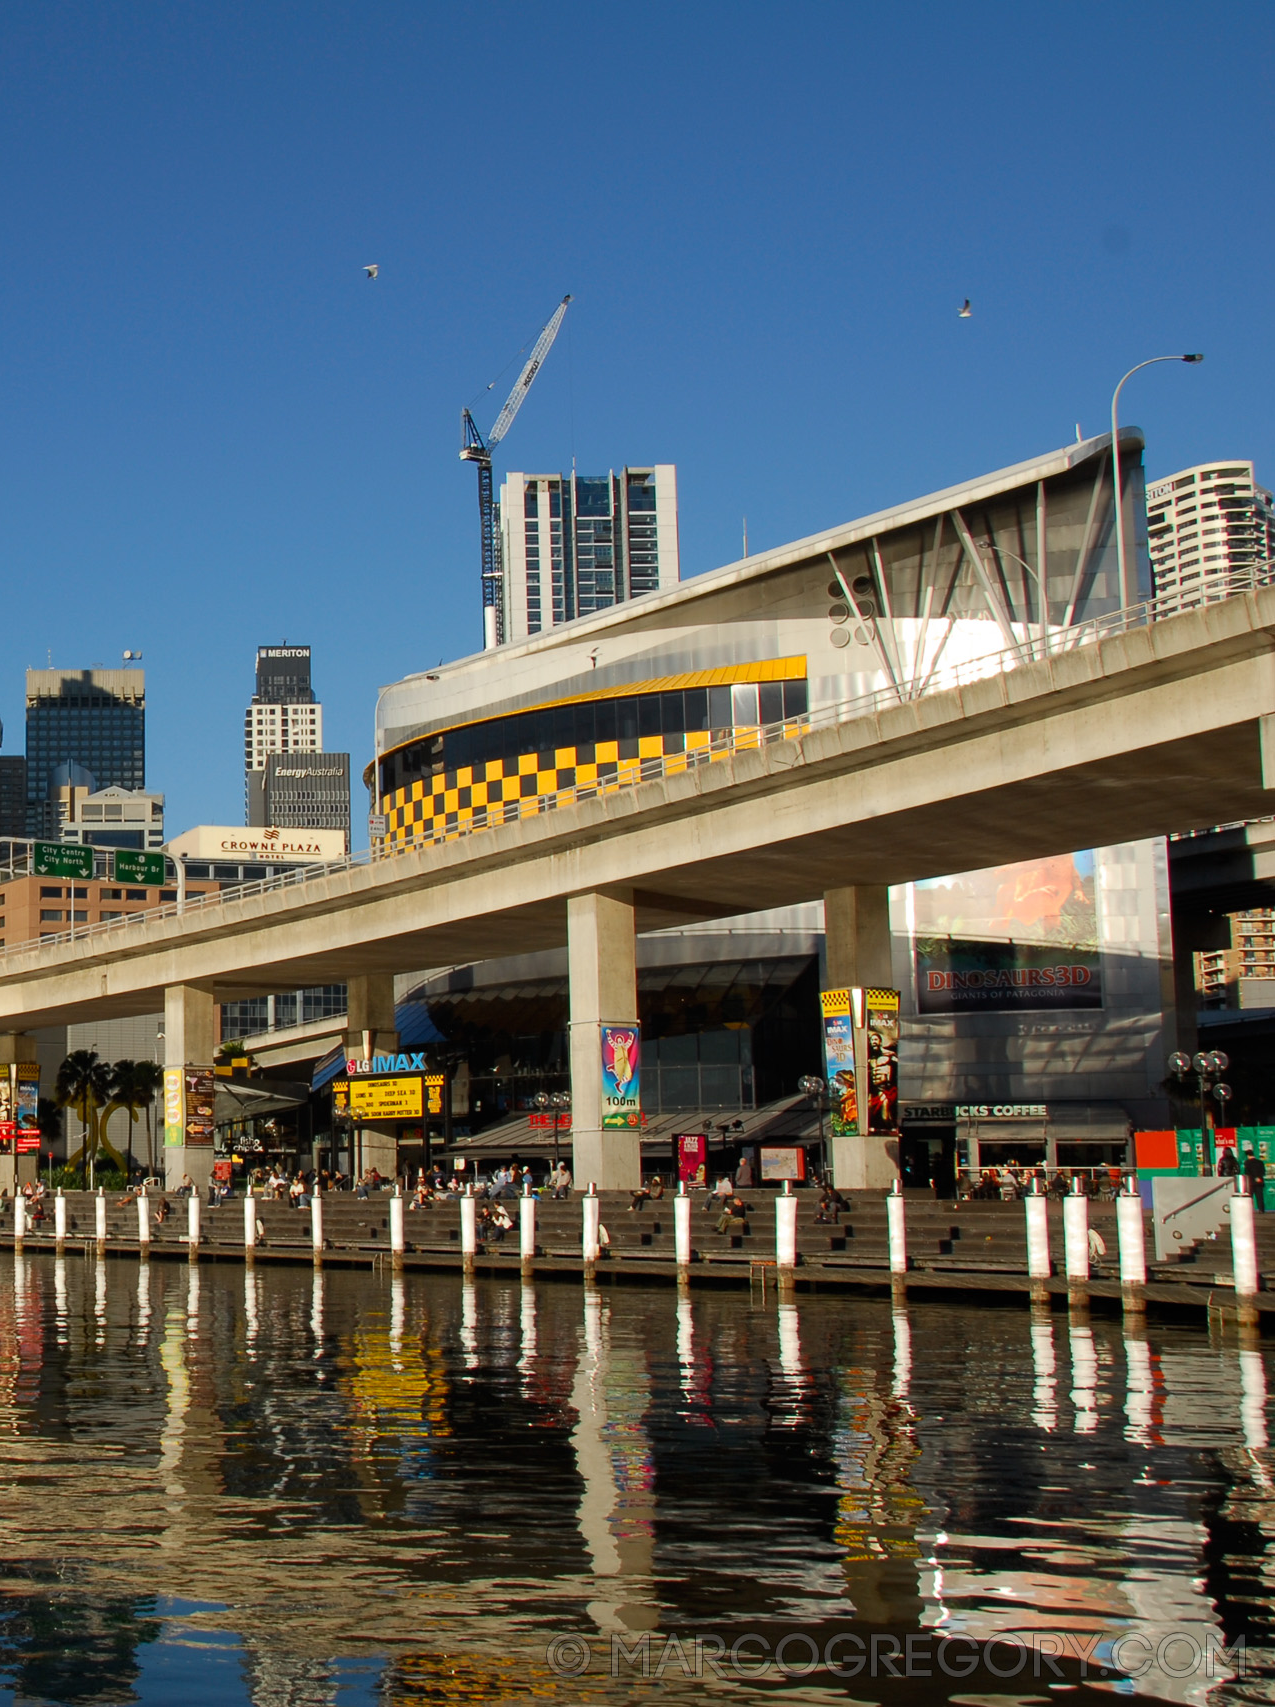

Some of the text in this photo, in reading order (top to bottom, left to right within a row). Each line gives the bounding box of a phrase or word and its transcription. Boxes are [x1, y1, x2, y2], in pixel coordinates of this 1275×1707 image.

[268, 649, 310, 657] MERITON
[275, 766, 343, 778] EnergyAustralia
[42, 846, 85, 857] City Centre
[221, 841, 321, 852] CROWNE PLAZA
[44, 855, 84, 865] City North
[119, 864, 148, 872] Harbour
[950, 991, 987, 1000] GIANTS
[1006, 989, 1065, 998] PATAGONIA
[870, 1019, 894, 1027] IMAX
[827, 1026, 848, 1034] IMAX
[356, 1052, 426, 1073] LG IMAX
[606, 1097, 636, 1106] 100m
[904, 1104, 1047, 1117] STARBUCKS COFFEE
[528, 1114, 550, 1125] THE
[240, 1136, 254, 1145] fish
